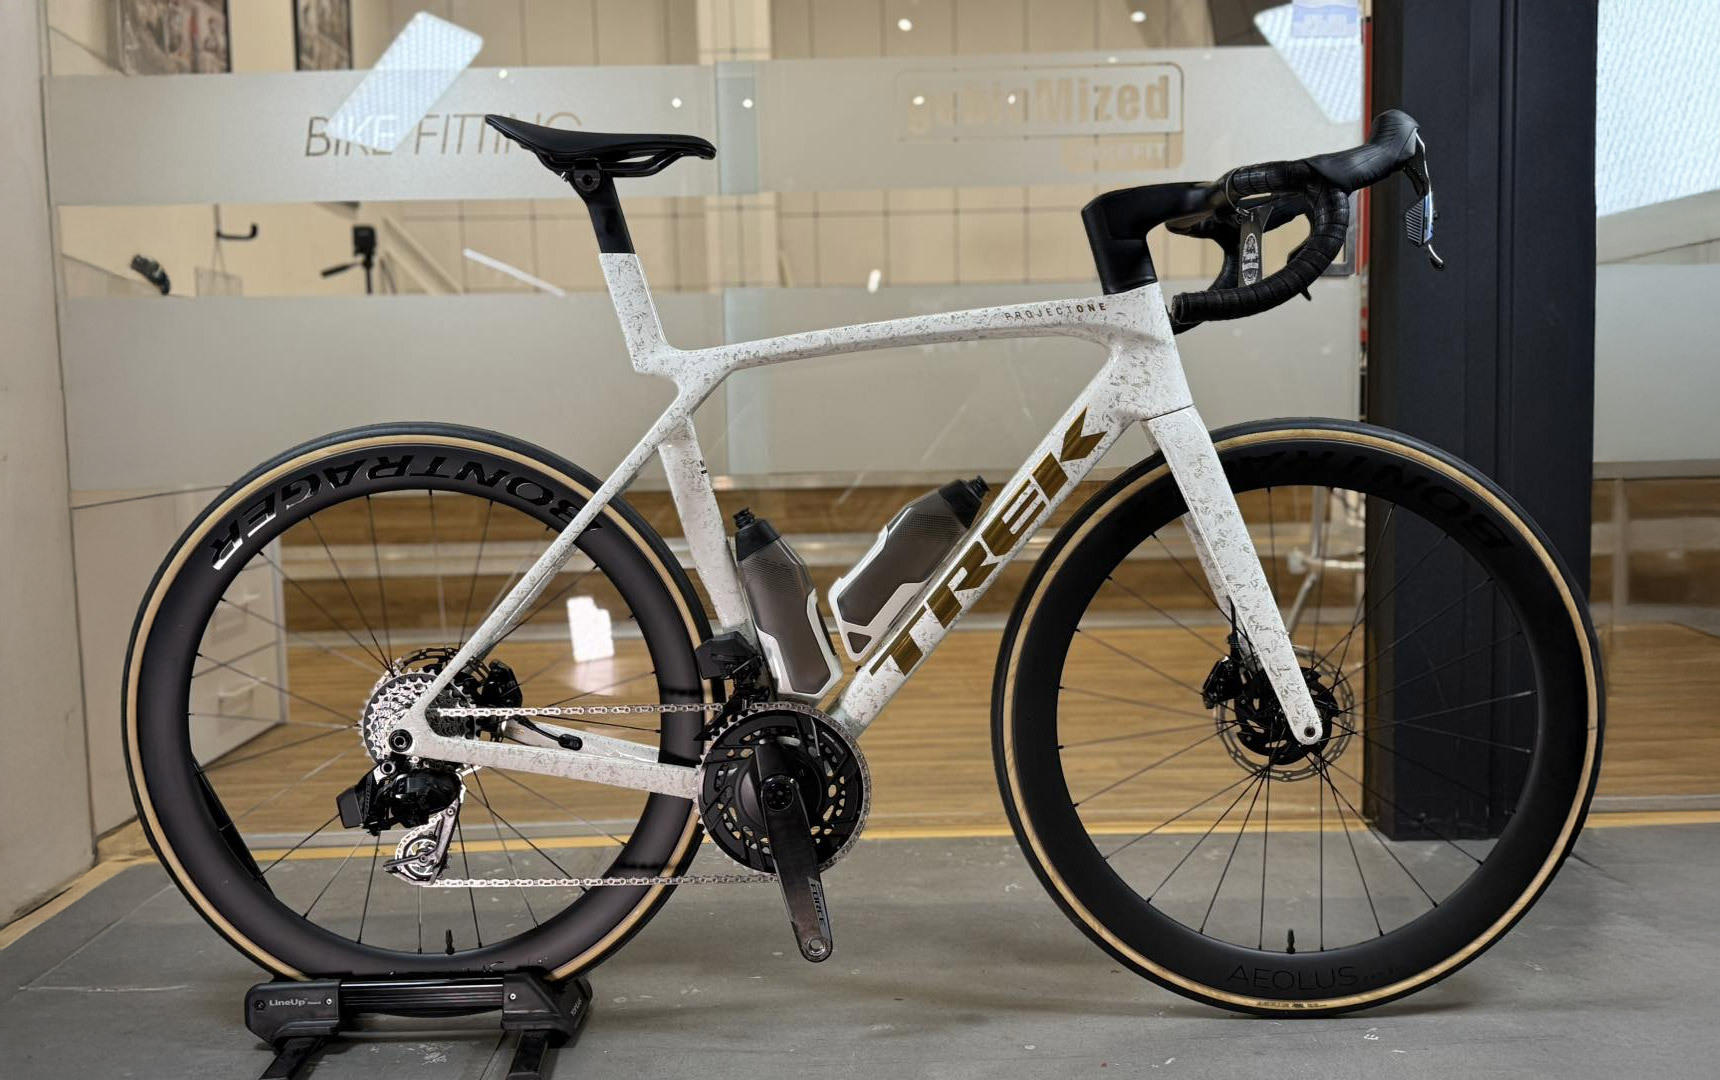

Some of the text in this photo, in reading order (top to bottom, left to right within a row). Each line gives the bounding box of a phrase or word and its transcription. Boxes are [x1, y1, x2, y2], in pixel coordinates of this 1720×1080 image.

[304, 113, 401, 157] BIKE
[869, 406, 1107, 677] TREK
[1226, 964, 1359, 991] AEOLUS
[268, 998, 306, 1007] LineUp
